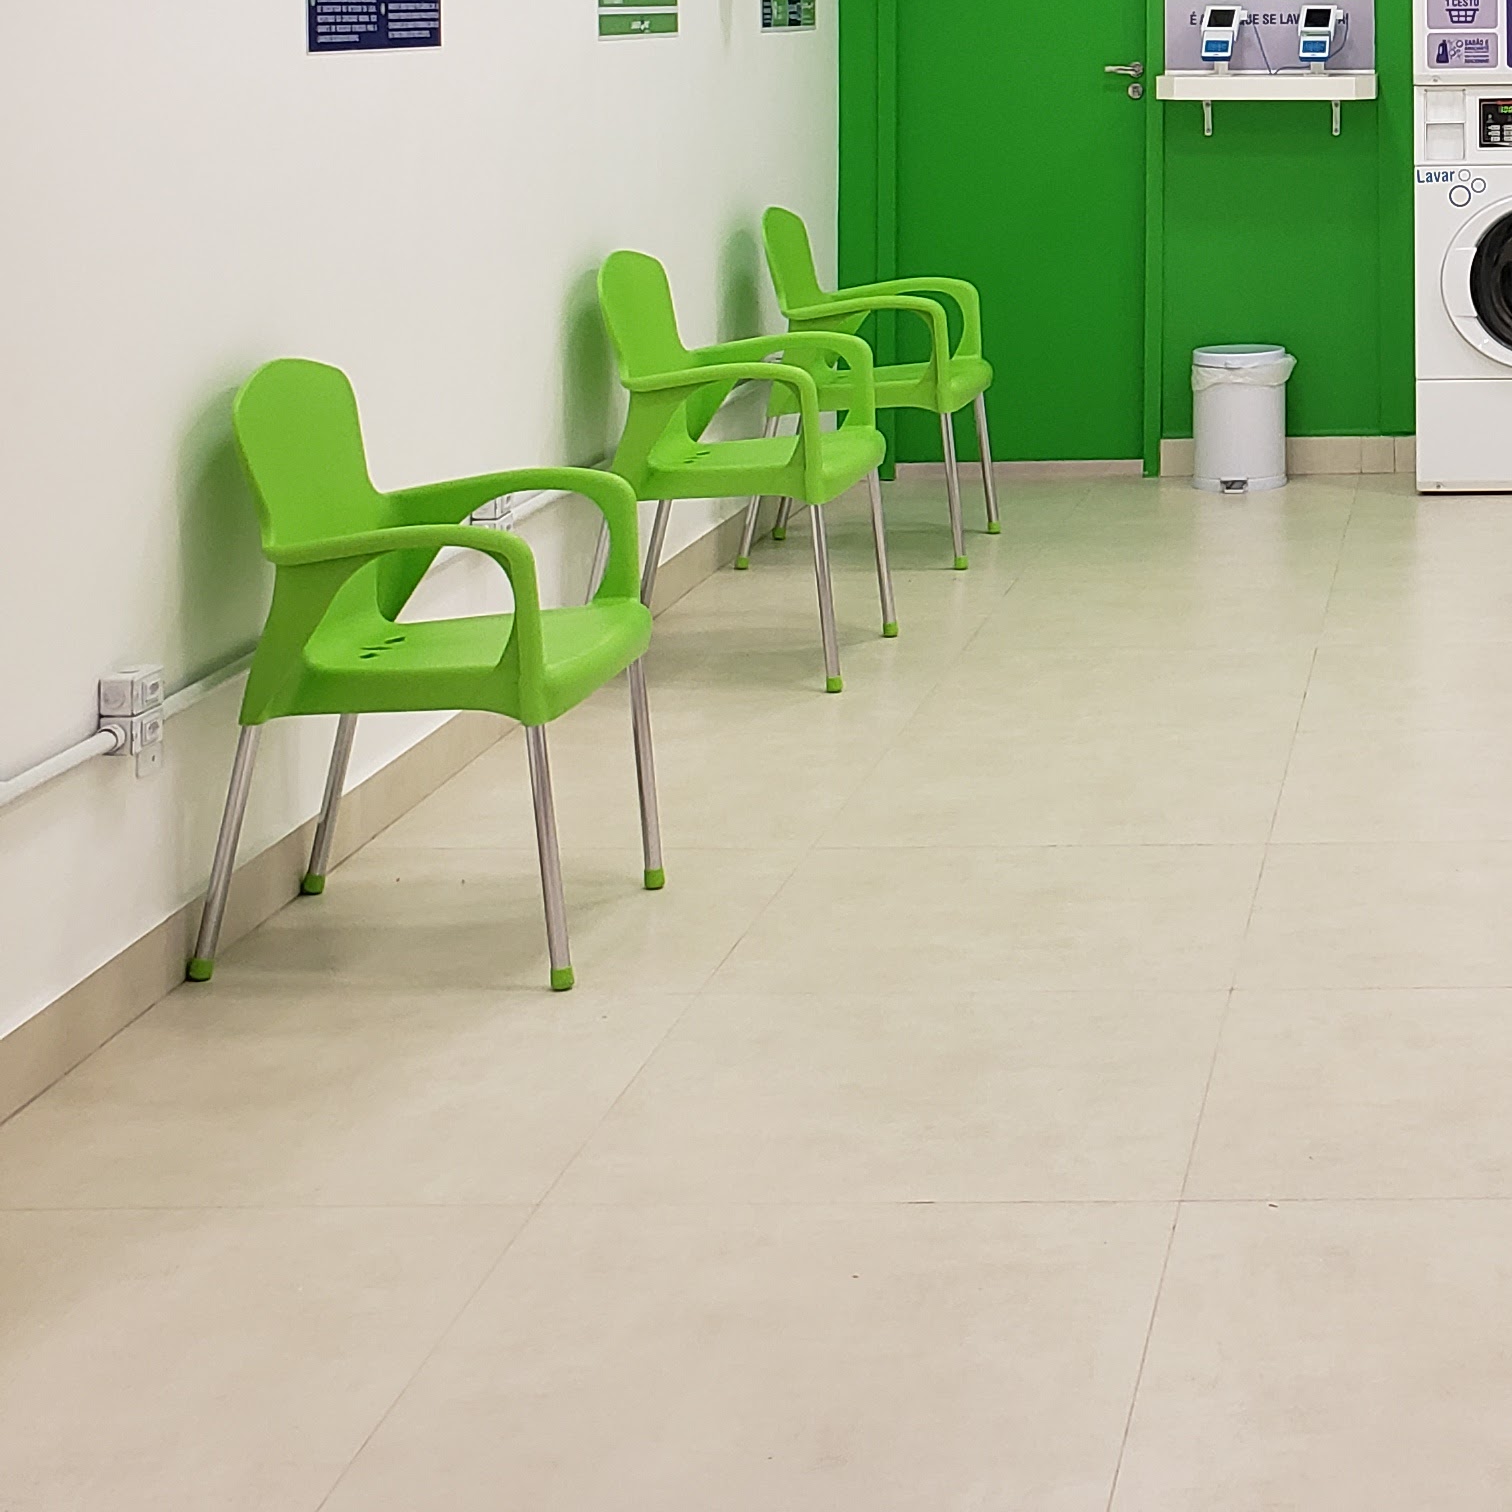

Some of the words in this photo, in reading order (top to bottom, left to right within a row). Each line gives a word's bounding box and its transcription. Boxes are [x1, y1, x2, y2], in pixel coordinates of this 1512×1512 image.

[1190, 11, 1197, 26] É
[1262, 13, 1277, 25] SE
[1416, 168, 1455, 184] Lavar
